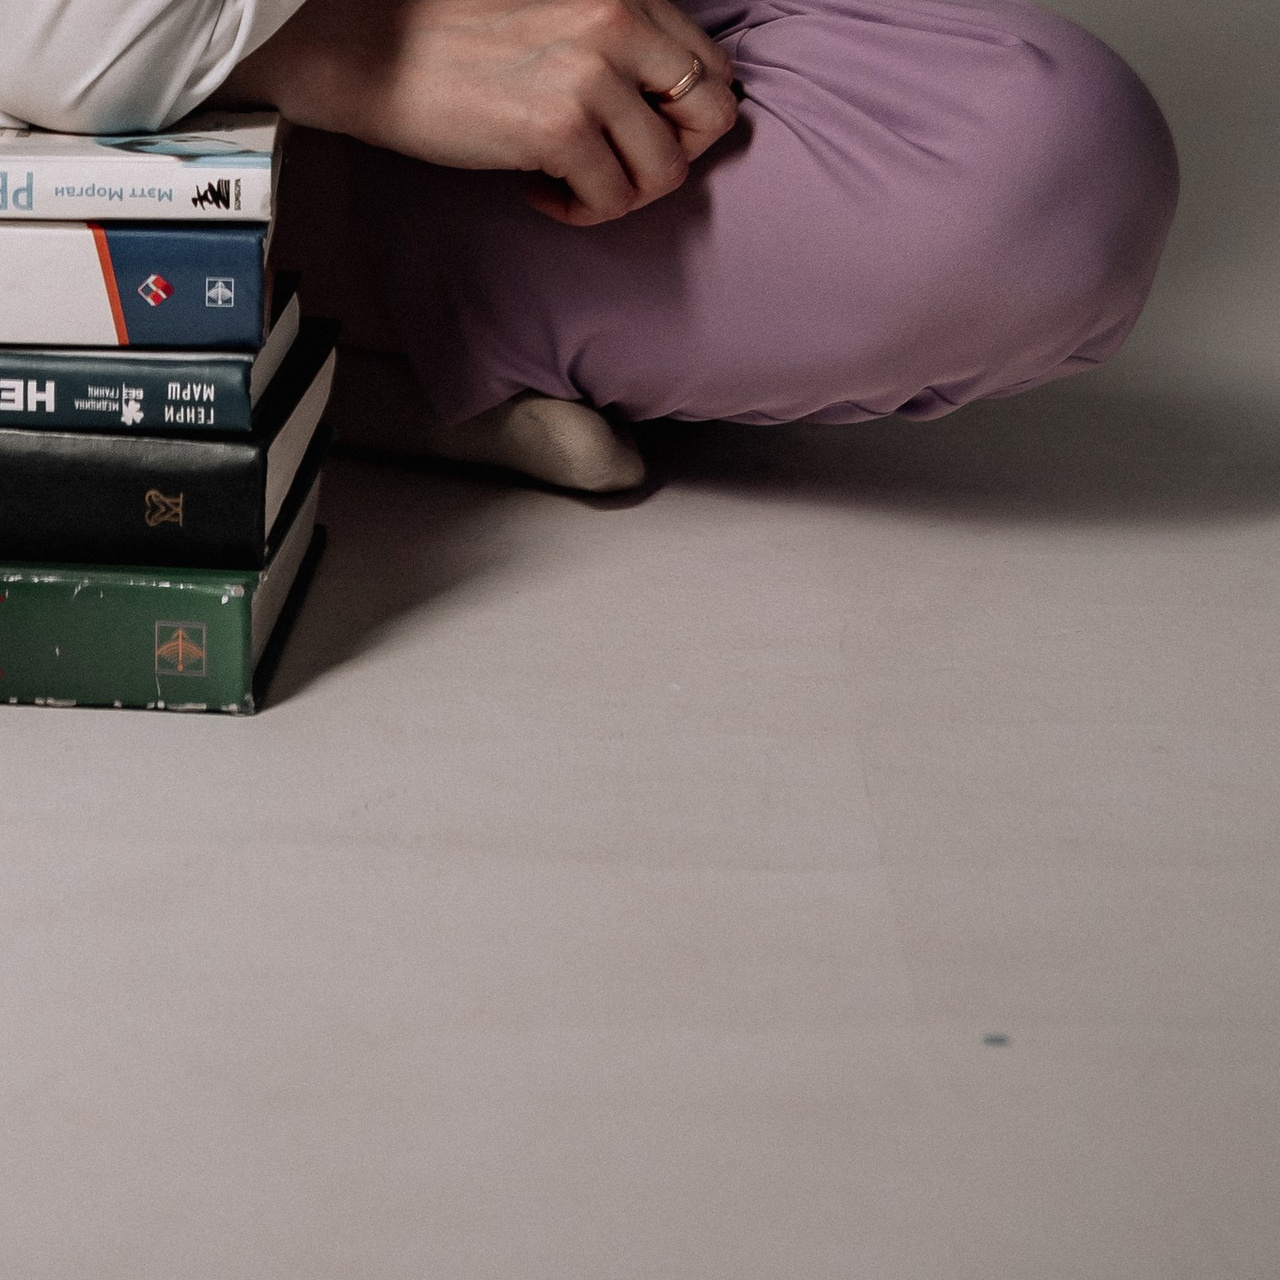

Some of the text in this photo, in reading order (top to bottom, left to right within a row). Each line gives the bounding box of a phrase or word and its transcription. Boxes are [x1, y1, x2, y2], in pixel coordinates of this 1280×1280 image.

[54, 183, 173, 203] Мэтт Морган
[87, 384, 144, 400] БЕЗ ГРАНИЦ
[167, 381, 215, 402] МАРШ
[74, 398, 119, 412] МЕДИЦИНА
[164, 404, 215, 425] ГЕНРИ
